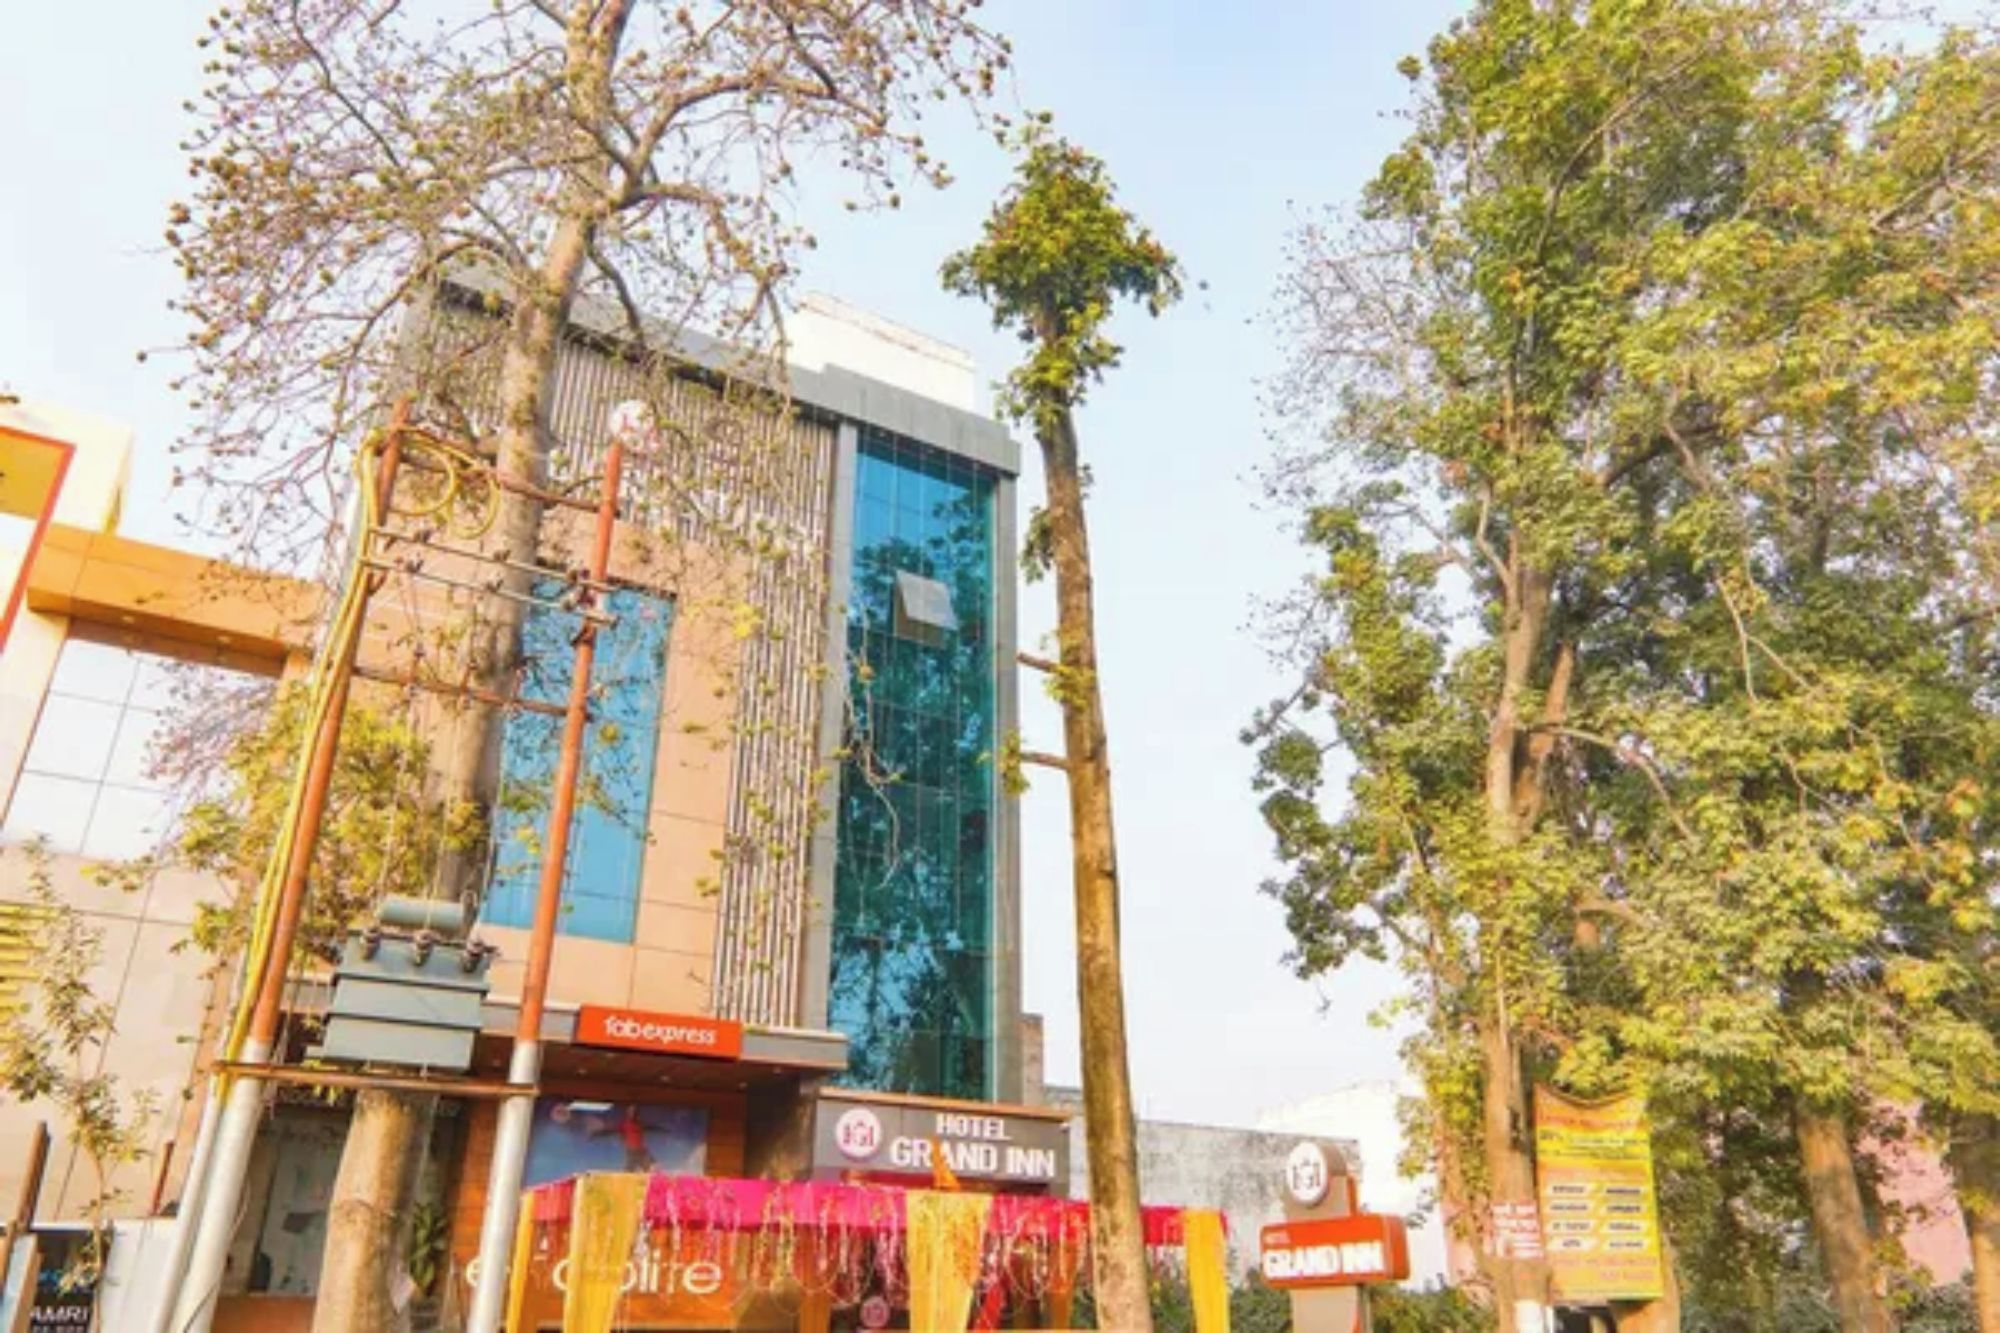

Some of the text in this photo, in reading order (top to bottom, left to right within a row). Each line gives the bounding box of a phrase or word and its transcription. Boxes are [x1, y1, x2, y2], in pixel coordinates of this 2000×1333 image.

[604, 1015, 716, 1046] fabexpress
[935, 1112, 1011, 1141] HOTEL
[890, 1136, 1056, 1178] GRAND INN
